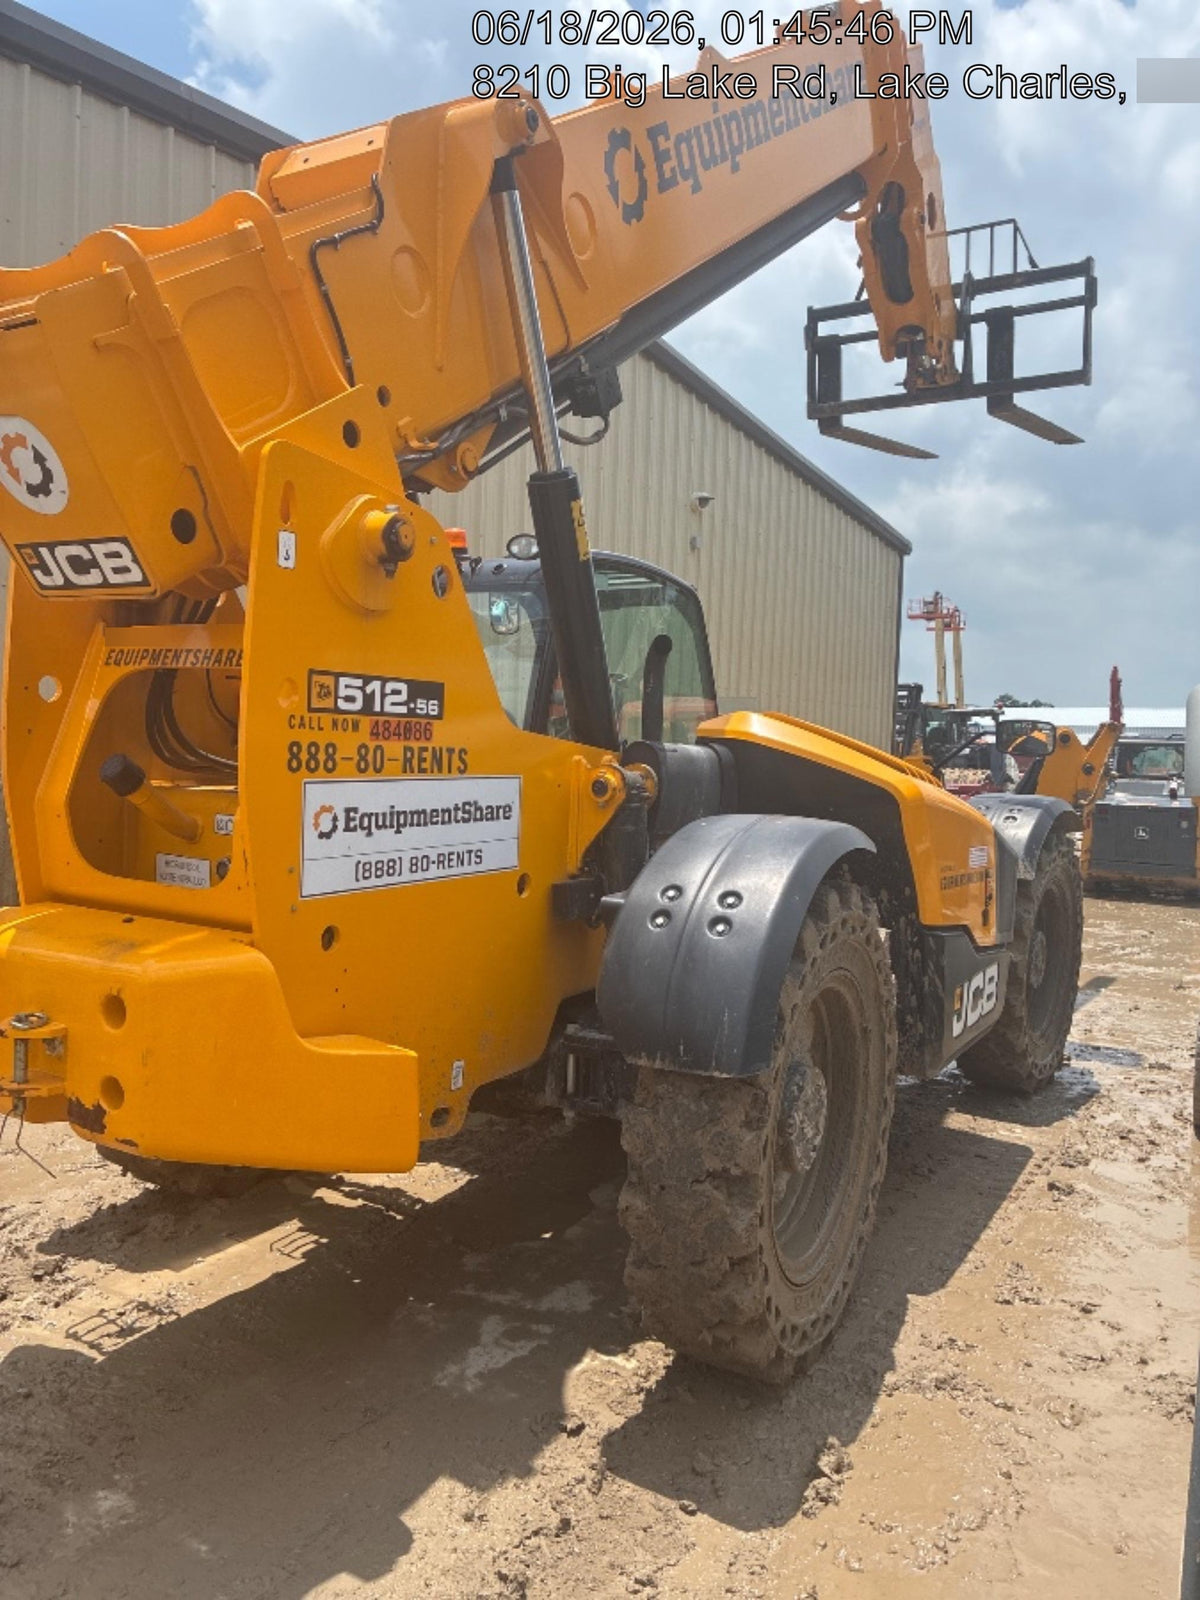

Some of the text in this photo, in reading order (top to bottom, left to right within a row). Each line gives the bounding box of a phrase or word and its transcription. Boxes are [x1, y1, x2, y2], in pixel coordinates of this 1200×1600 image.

[32, 541, 143, 586] JCB
[288, 714, 361, 732] CALL NOW
[369, 719, 433, 742] 484086
[287, 741, 468, 774] 888-80-RENTS
[343, 801, 513, 837] EquipmentShare
[354, 848, 484, 883] (888) 80-RENTS
[952, 961, 998, 1037] JCB
